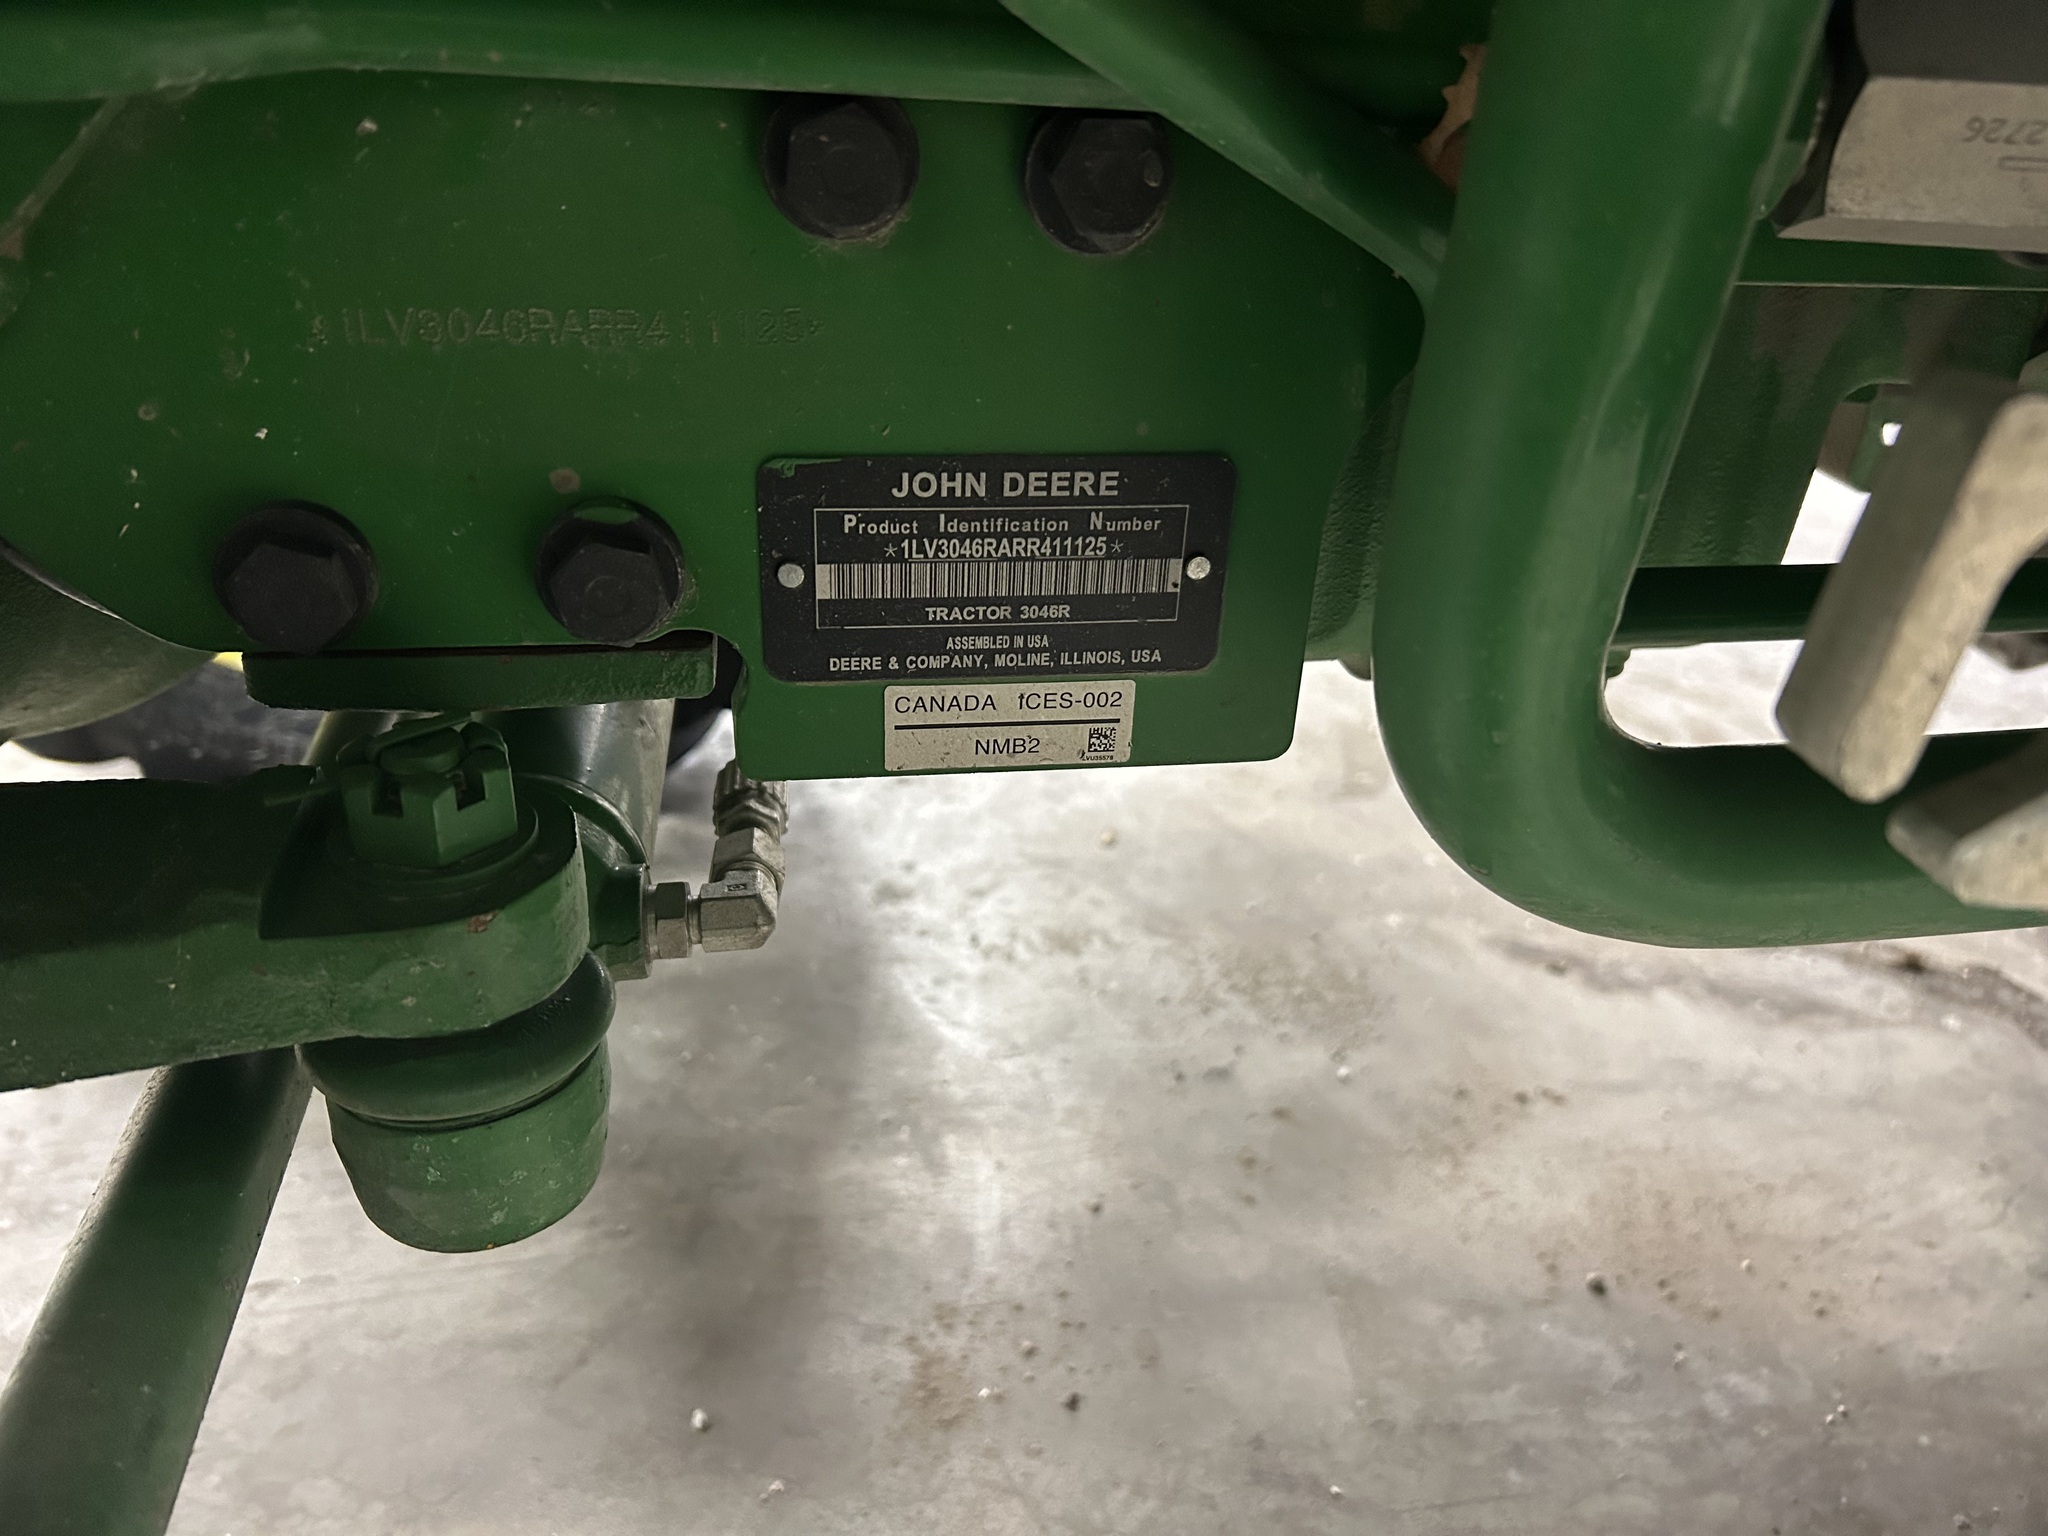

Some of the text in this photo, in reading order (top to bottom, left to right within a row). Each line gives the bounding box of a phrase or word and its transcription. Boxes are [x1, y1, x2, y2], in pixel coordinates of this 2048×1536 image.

[891, 470, 1120, 499] JOHN DEERE
[843, 511, 1162, 535] Product Identification Number
[925, 604, 1071, 621] TRACTOR 3046R
[946, 634, 1050, 651] ASSEMBLED IN USA
[829, 649, 1162, 671] DEERE & COMPANY, MOLINE, ILLINOIS, USA
[894, 691, 1123, 713] CANADA ICES-002
[975, 737, 1041, 756] NMB2
